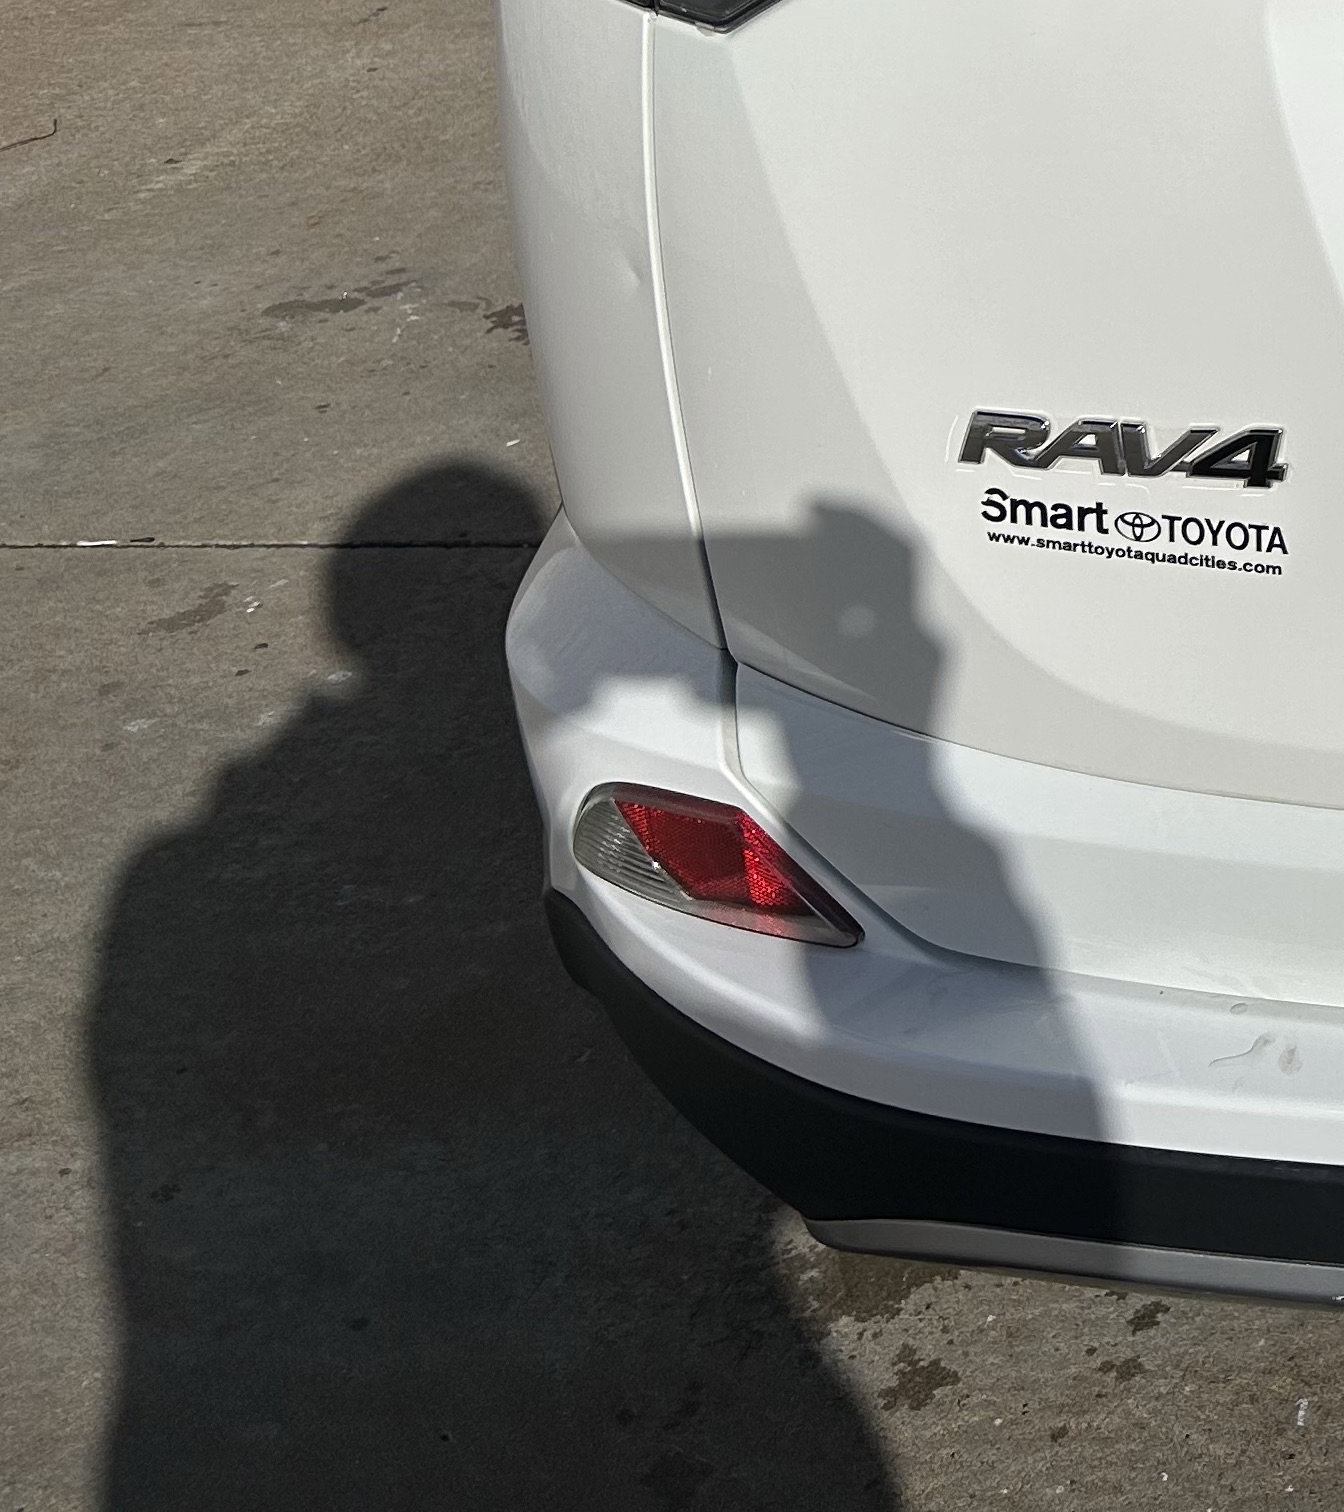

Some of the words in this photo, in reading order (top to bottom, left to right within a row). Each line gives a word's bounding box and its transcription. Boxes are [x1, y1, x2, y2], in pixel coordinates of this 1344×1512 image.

[957, 410, 1289, 489] RAV4
[980, 487, 1109, 535] Smart
[1161, 513, 1290, 555] TOYOTA
[986, 530, 1283, 576] www.smarttoyotaquadcities.com
